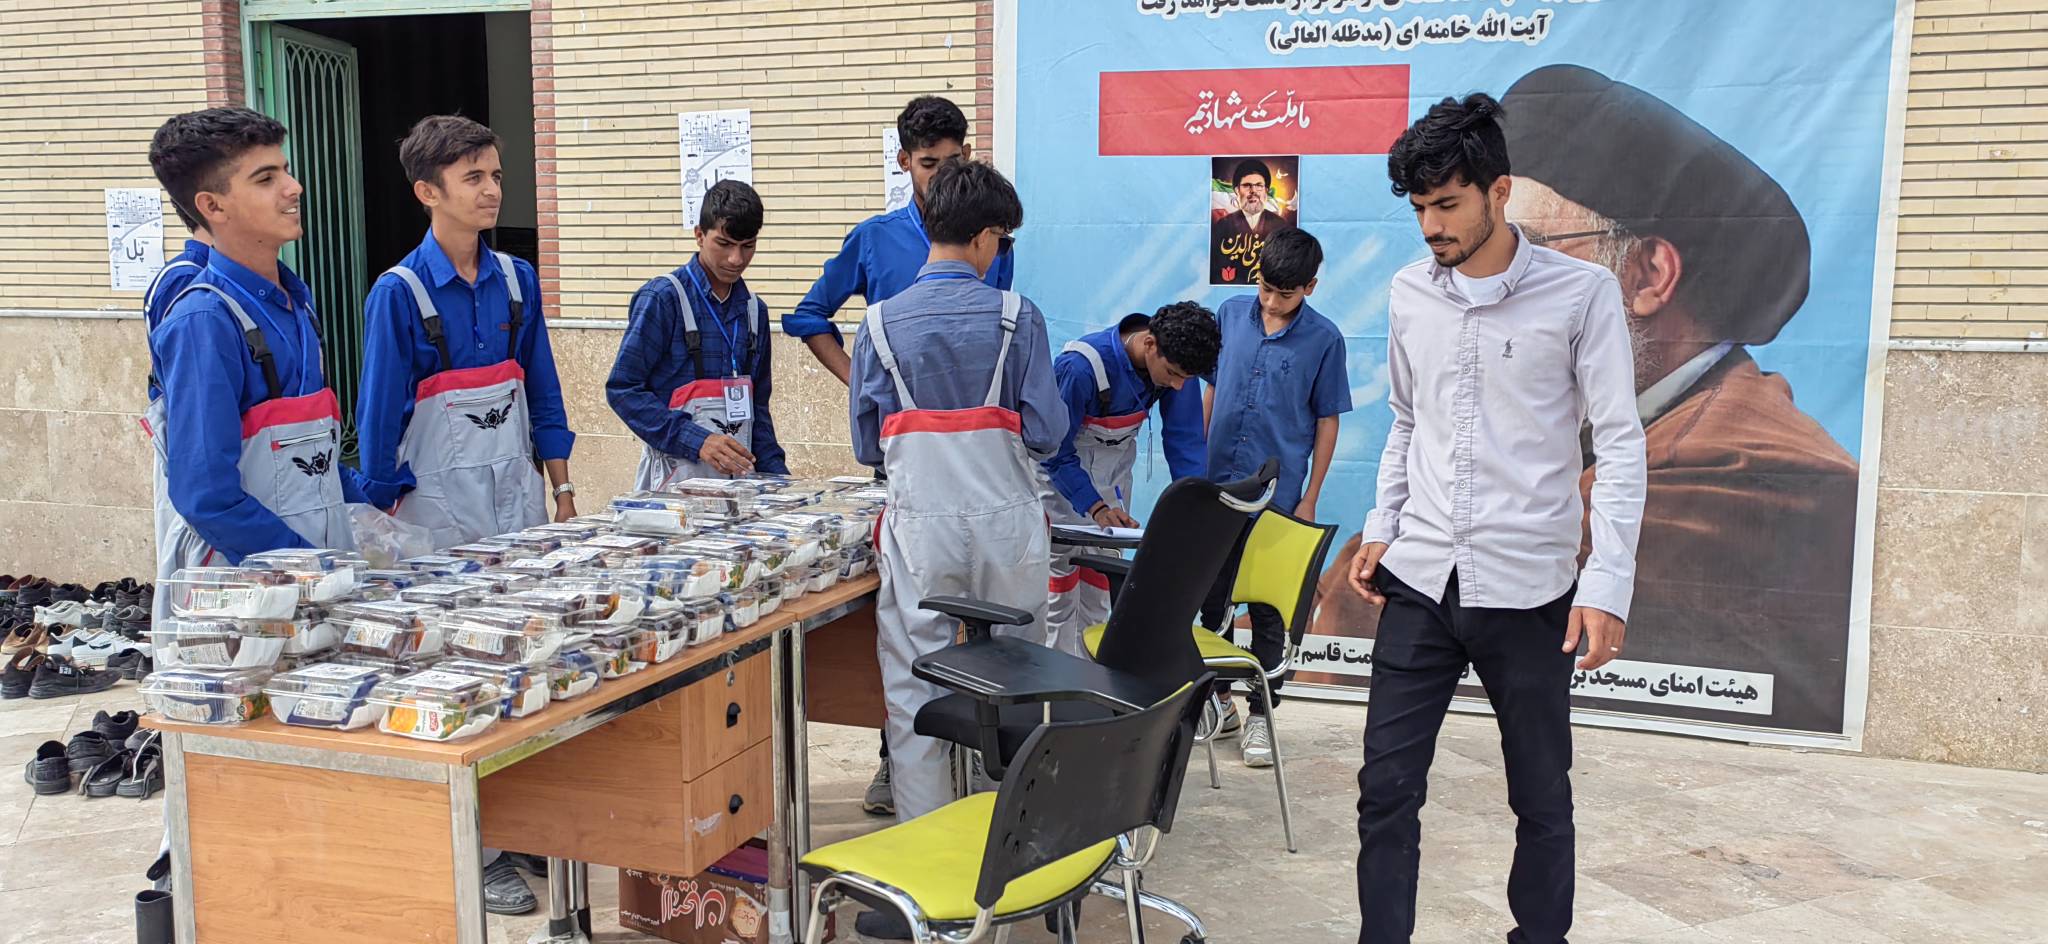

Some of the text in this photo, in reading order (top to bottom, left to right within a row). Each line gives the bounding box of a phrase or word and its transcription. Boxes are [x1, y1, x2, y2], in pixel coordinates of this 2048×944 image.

[1396, 22, 1419, 46] ای
[1424, 19, 1471, 39] خامنه
[1510, 14, 1549, 40] آیت
[1298, 100, 1311, 129] ما
[1301, 642, 1342, 665] قاسم
[1588, 669, 1648, 692] مسجد
[1649, 672, 1704, 697] امنای
[1705, 678, 1759, 705] هیئت
